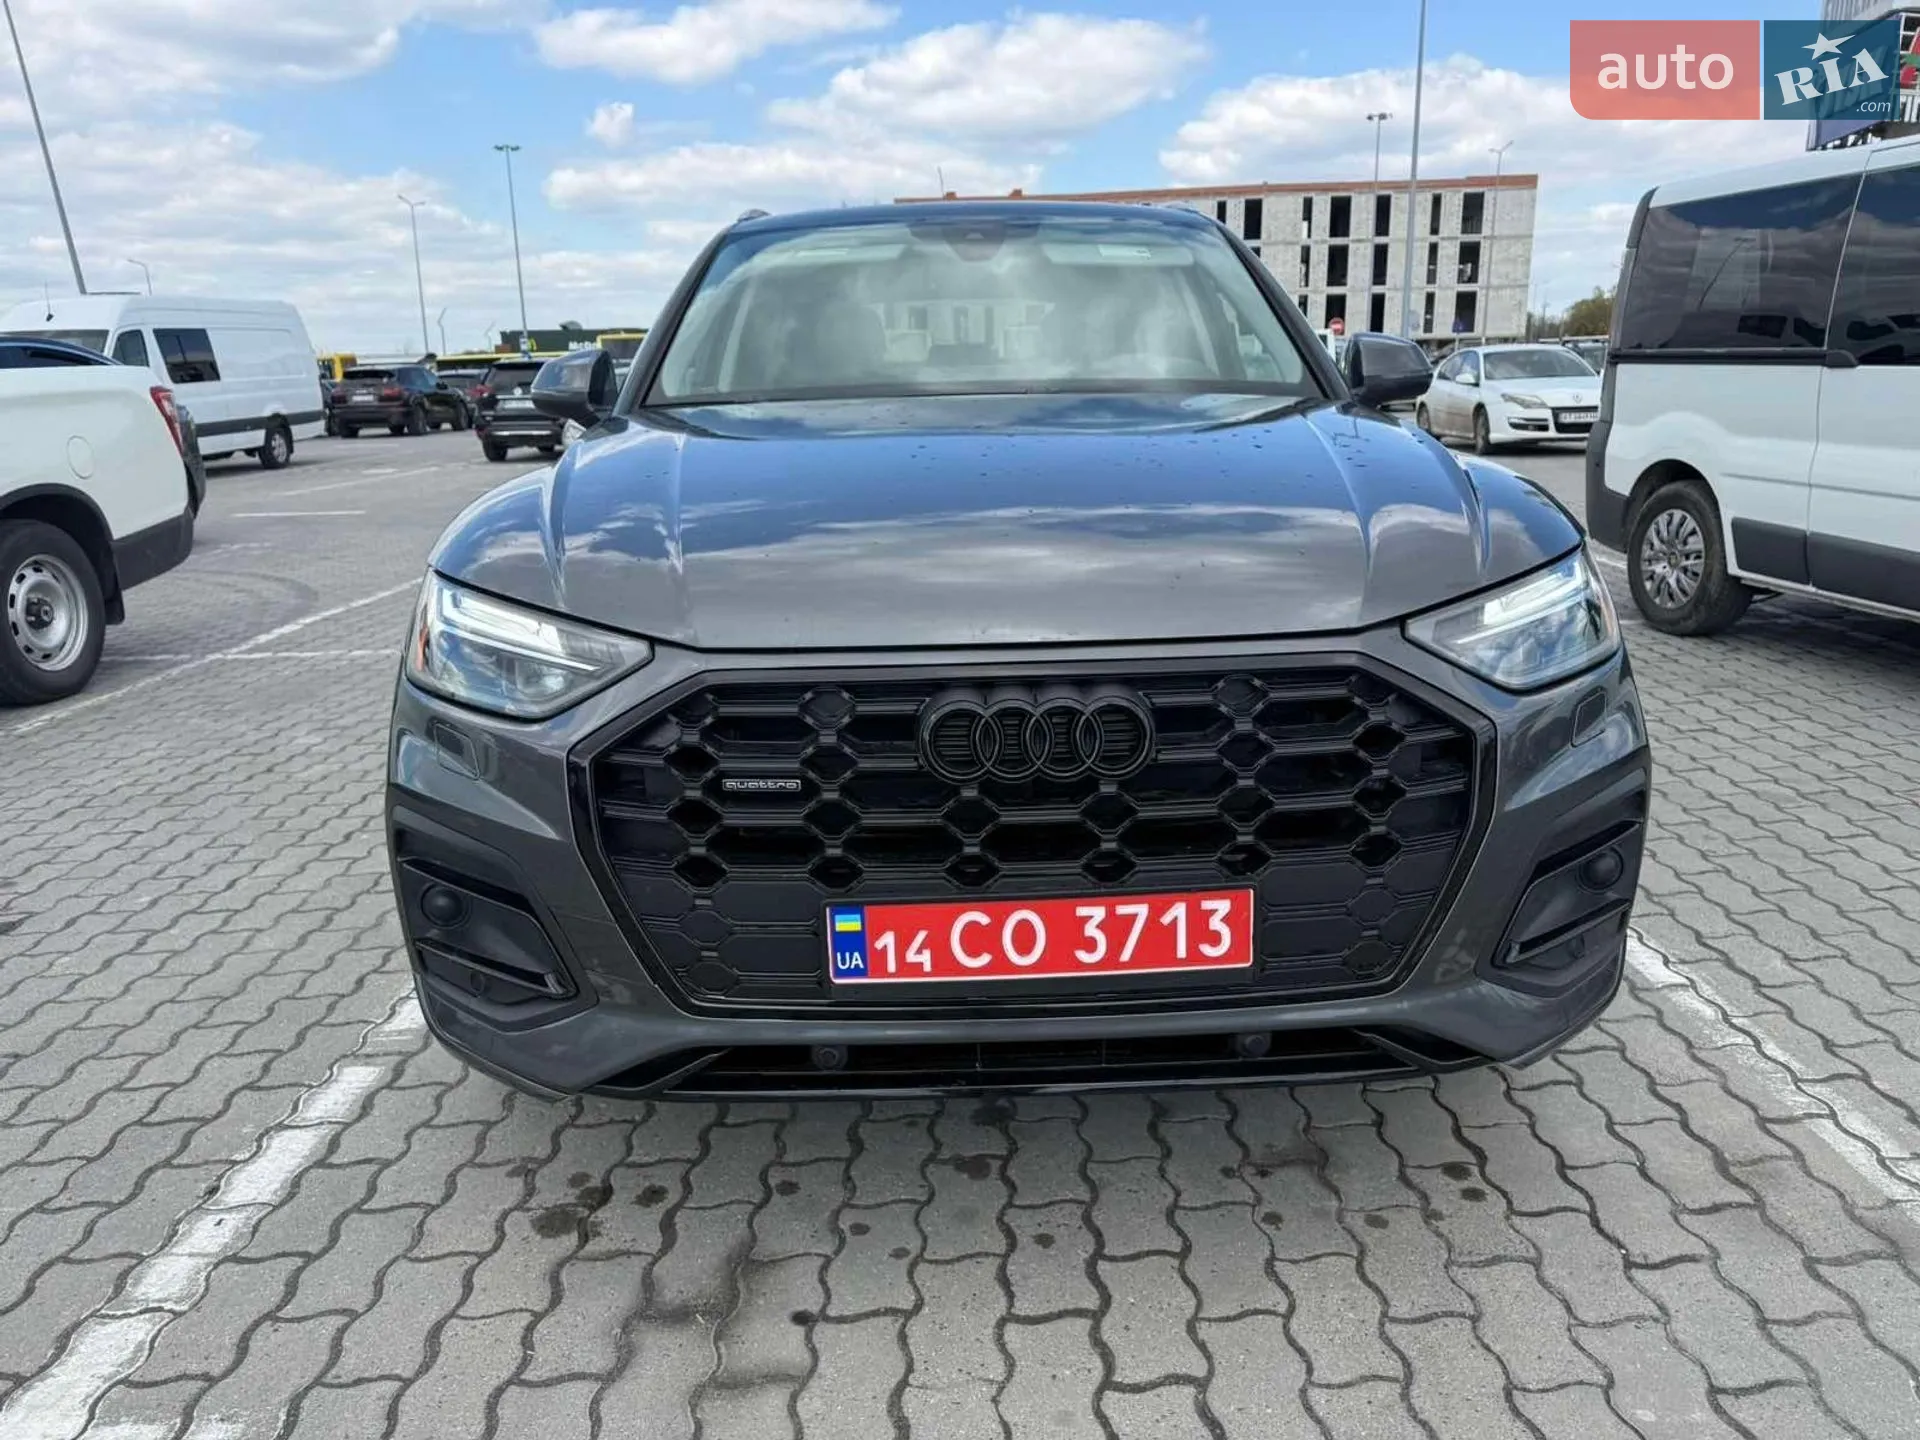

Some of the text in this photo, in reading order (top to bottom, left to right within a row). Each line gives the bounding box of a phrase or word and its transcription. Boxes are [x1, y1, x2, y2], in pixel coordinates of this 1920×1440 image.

[725, 782, 797, 790] quattro
[873, 899, 1232, 973] 14 CO 3713
[836, 951, 865, 970] UA
